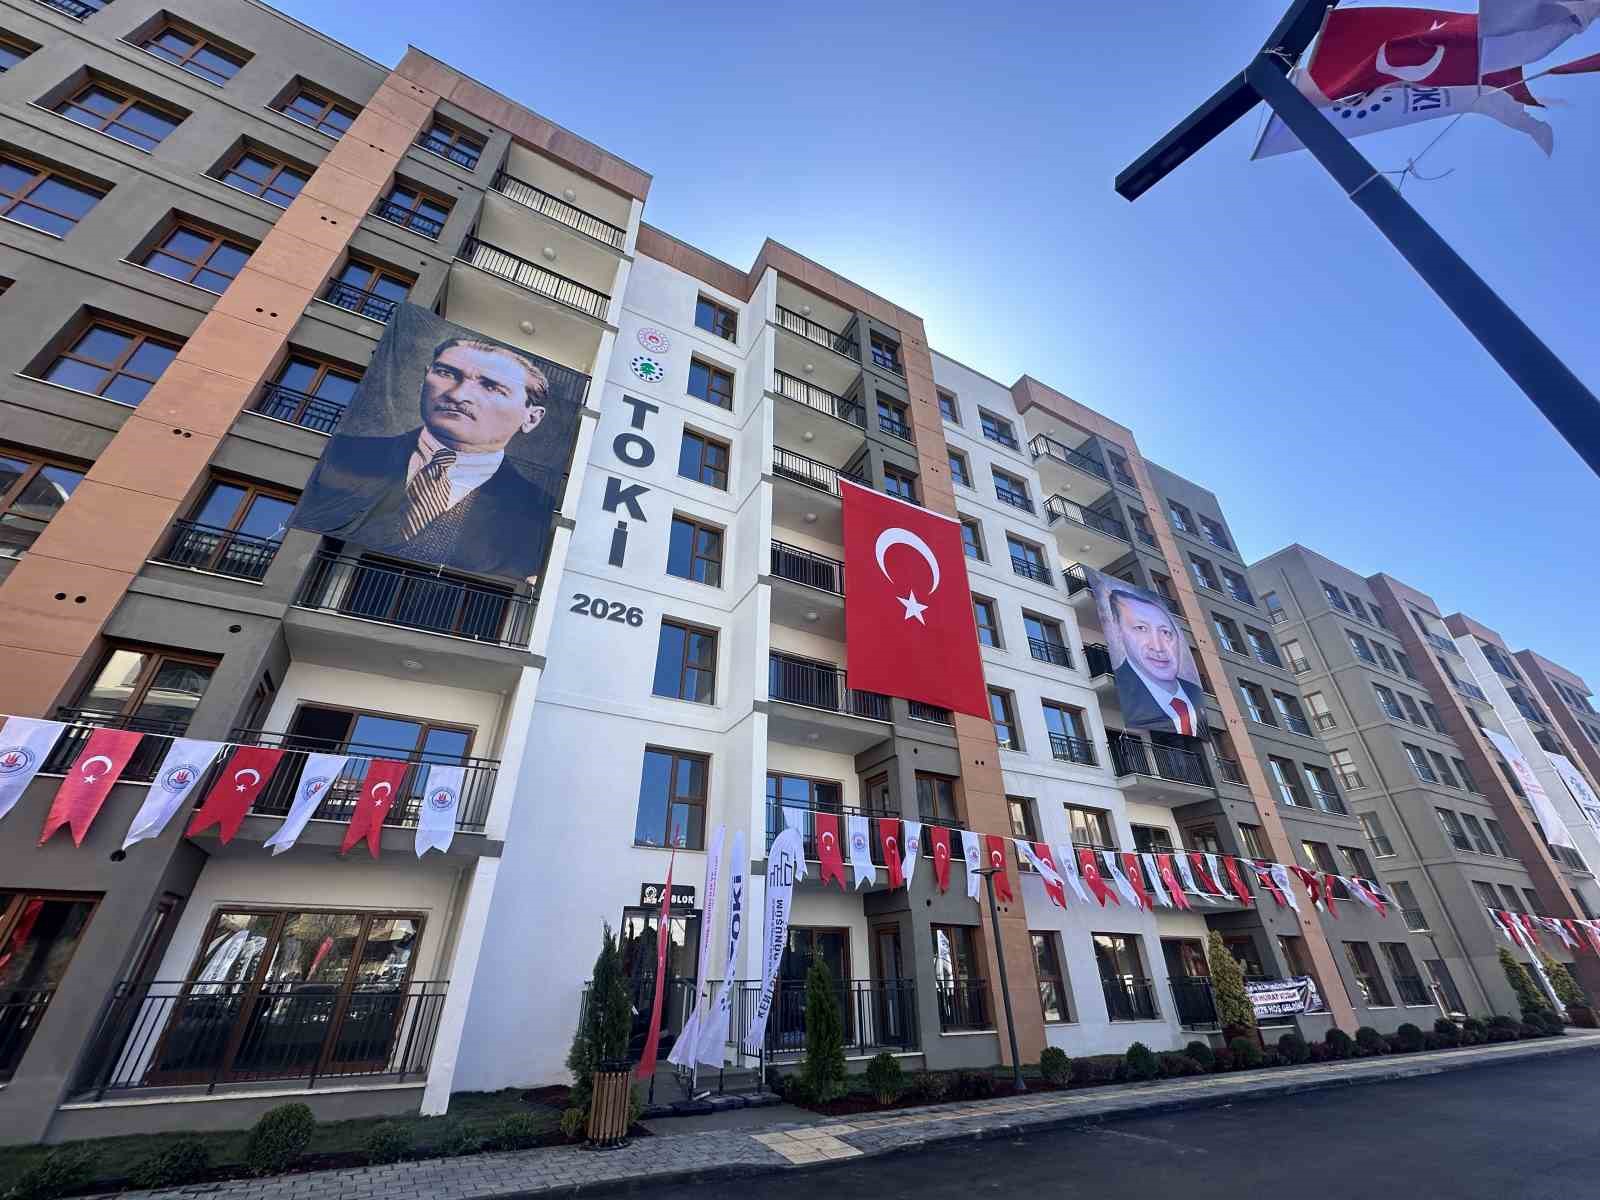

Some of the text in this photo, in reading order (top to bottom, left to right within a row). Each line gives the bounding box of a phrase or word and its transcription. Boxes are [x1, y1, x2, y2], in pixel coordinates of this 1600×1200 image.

[602, 394, 659, 568] TOKİ
[570, 593, 644, 628] 2026
[671, 895, 695, 904] BLOK
